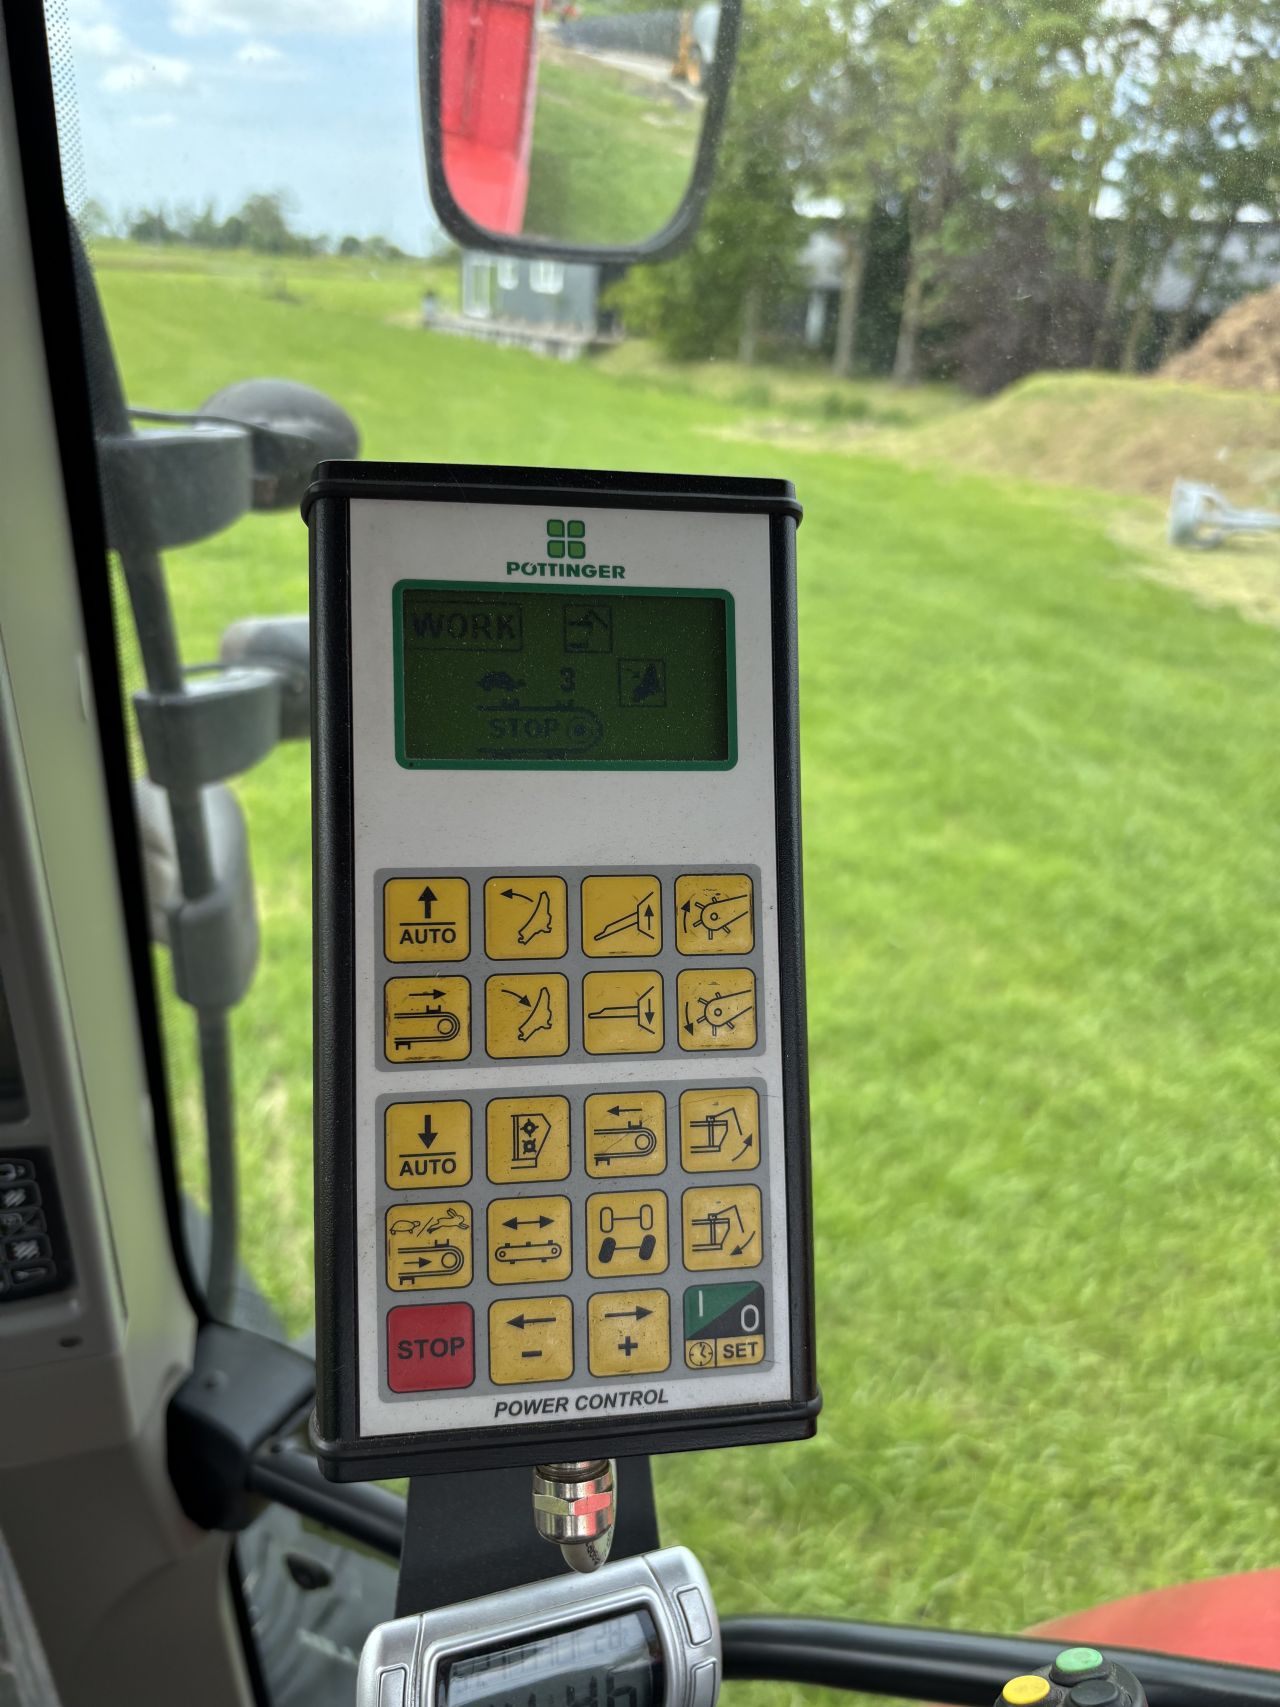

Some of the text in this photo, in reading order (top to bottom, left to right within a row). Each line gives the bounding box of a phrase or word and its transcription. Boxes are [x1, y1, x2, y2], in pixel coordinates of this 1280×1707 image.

[411, 611, 516, 640] WORK
[559, 666, 576, 693] 3
[489, 717, 560, 739] STOP
[399, 926, 457, 945] AUTO
[399, 1157, 457, 1177] AUTO
[397, 1337, 466, 1360] STOP
[723, 1341, 758, 1359] SET
[494, 1388, 669, 1418] POWER CONTROL
